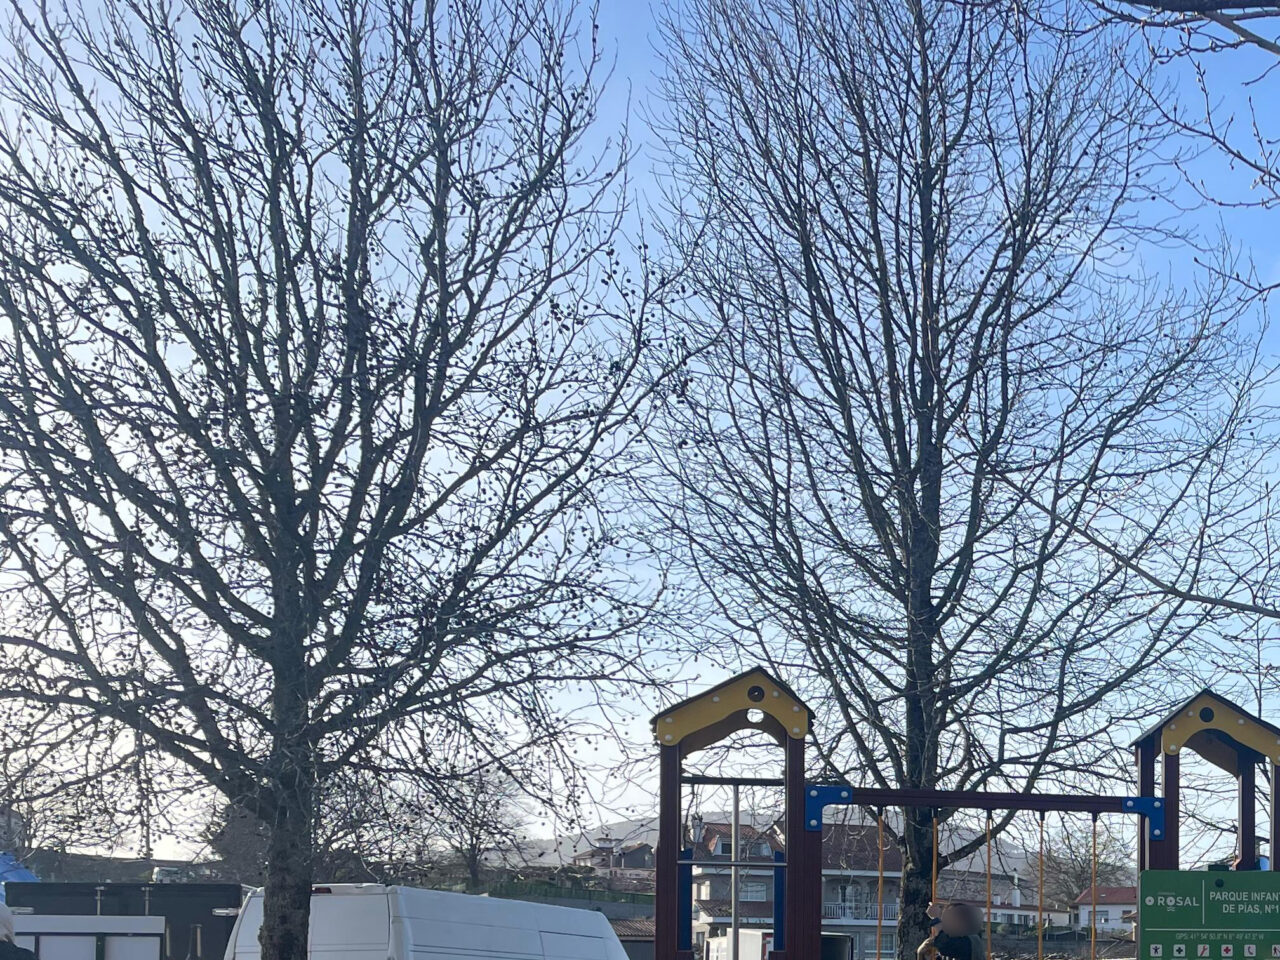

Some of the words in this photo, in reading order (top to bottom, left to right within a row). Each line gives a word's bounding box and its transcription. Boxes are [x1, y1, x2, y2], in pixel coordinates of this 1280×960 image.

[1157, 896, 1200, 906] ROSAL
[1209, 891, 1249, 901] PARQUE
[1222, 904, 1235, 913] DE
